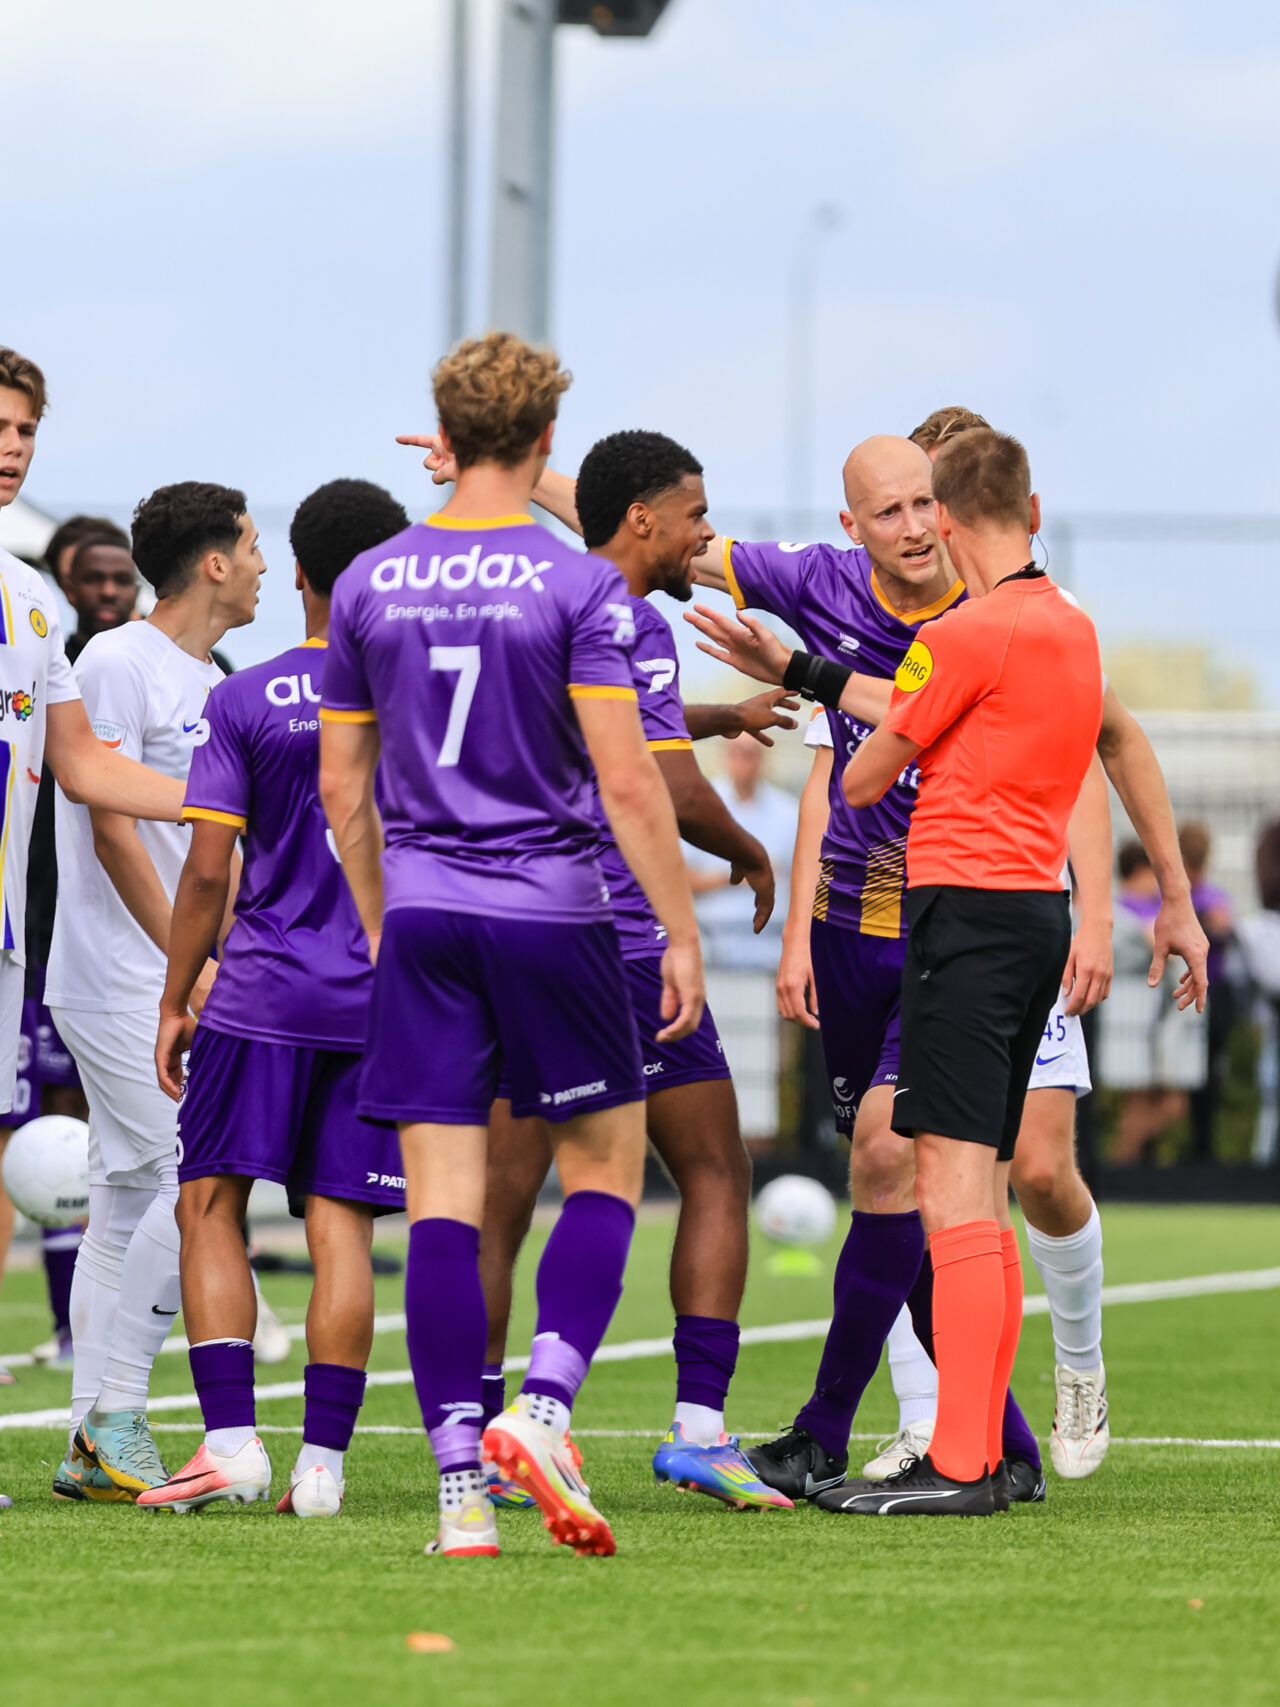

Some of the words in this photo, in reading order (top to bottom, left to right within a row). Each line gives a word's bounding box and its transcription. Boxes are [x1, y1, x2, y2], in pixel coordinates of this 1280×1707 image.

[371, 544, 554, 593] audax
[385, 603, 454, 624] Energie.
[455, 603, 477, 621] En
[902, 656, 927, 681] RAG
[428, 645, 481, 767] 7
[1041, 1014, 1066, 1042] 45
[553, 1079, 608, 1105] PATRICK
